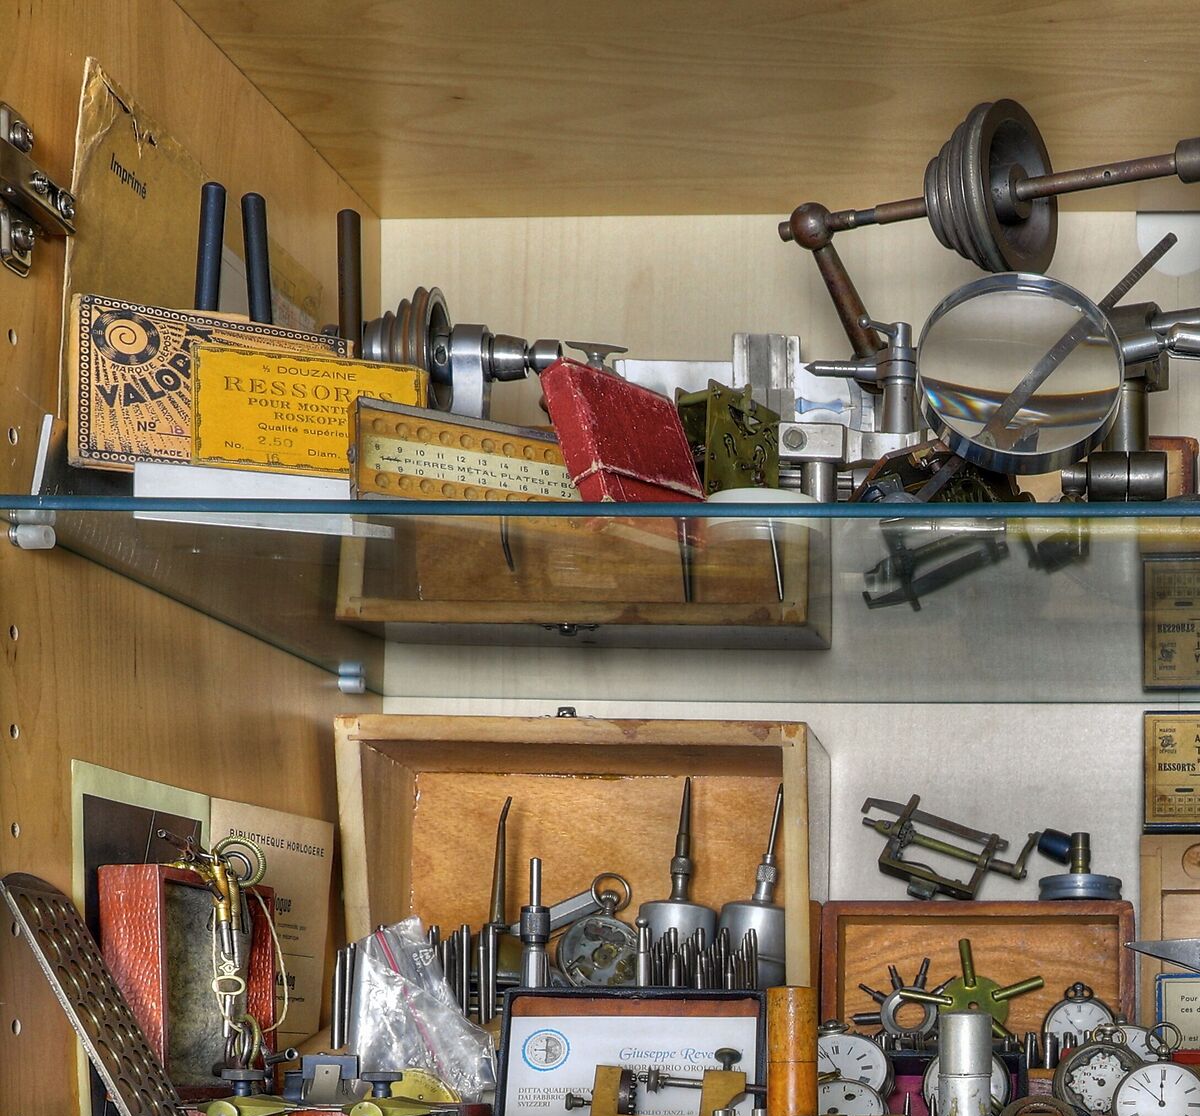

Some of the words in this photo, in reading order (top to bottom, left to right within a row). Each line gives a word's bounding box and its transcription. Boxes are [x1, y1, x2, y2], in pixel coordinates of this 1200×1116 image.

[111, 152, 147, 200] Imprimé
[110, 363, 155, 376] MARQUE
[278, 366, 357, 382] DOUZAINE
[248, 397, 290, 411] POUR
[274, 411, 348, 427] ROSKOPF
[258, 422, 298, 434] Qualité
[224, 440, 245, 450] No.
[257, 435, 293, 448] 2.50
[153, 448, 182, 458] MADE
[307, 448, 341, 459] Diam.
[415, 449, 425, 458] 10
[456, 455, 466, 464] 12
[478, 459, 487, 467] 13
[500, 462, 510, 470] 14
[520, 465, 529, 473] 15
[541, 469, 550, 477] 16
[404, 457, 454, 472] PIERRES
[457, 464, 497, 478] MÉTAL
[500, 472, 545, 486] PLATES
[415, 468, 424, 476] 10
[457, 474, 466, 482] 12
[478, 478, 487, 486] 13
[499, 481, 509, 489] 14
[519, 484, 528, 492] 16
[540, 487, 550, 495] 18
[1157, 762, 1196, 773] RESSORTS
[286, 840, 326, 858] HORLOGÈRE
[1181, 995, 1198, 1003] Pour
[618, 1046, 677, 1062] Giuseppe
[518, 1086, 543, 1095] DITTA
[517, 1100, 552, 1108] SVIZZERI
